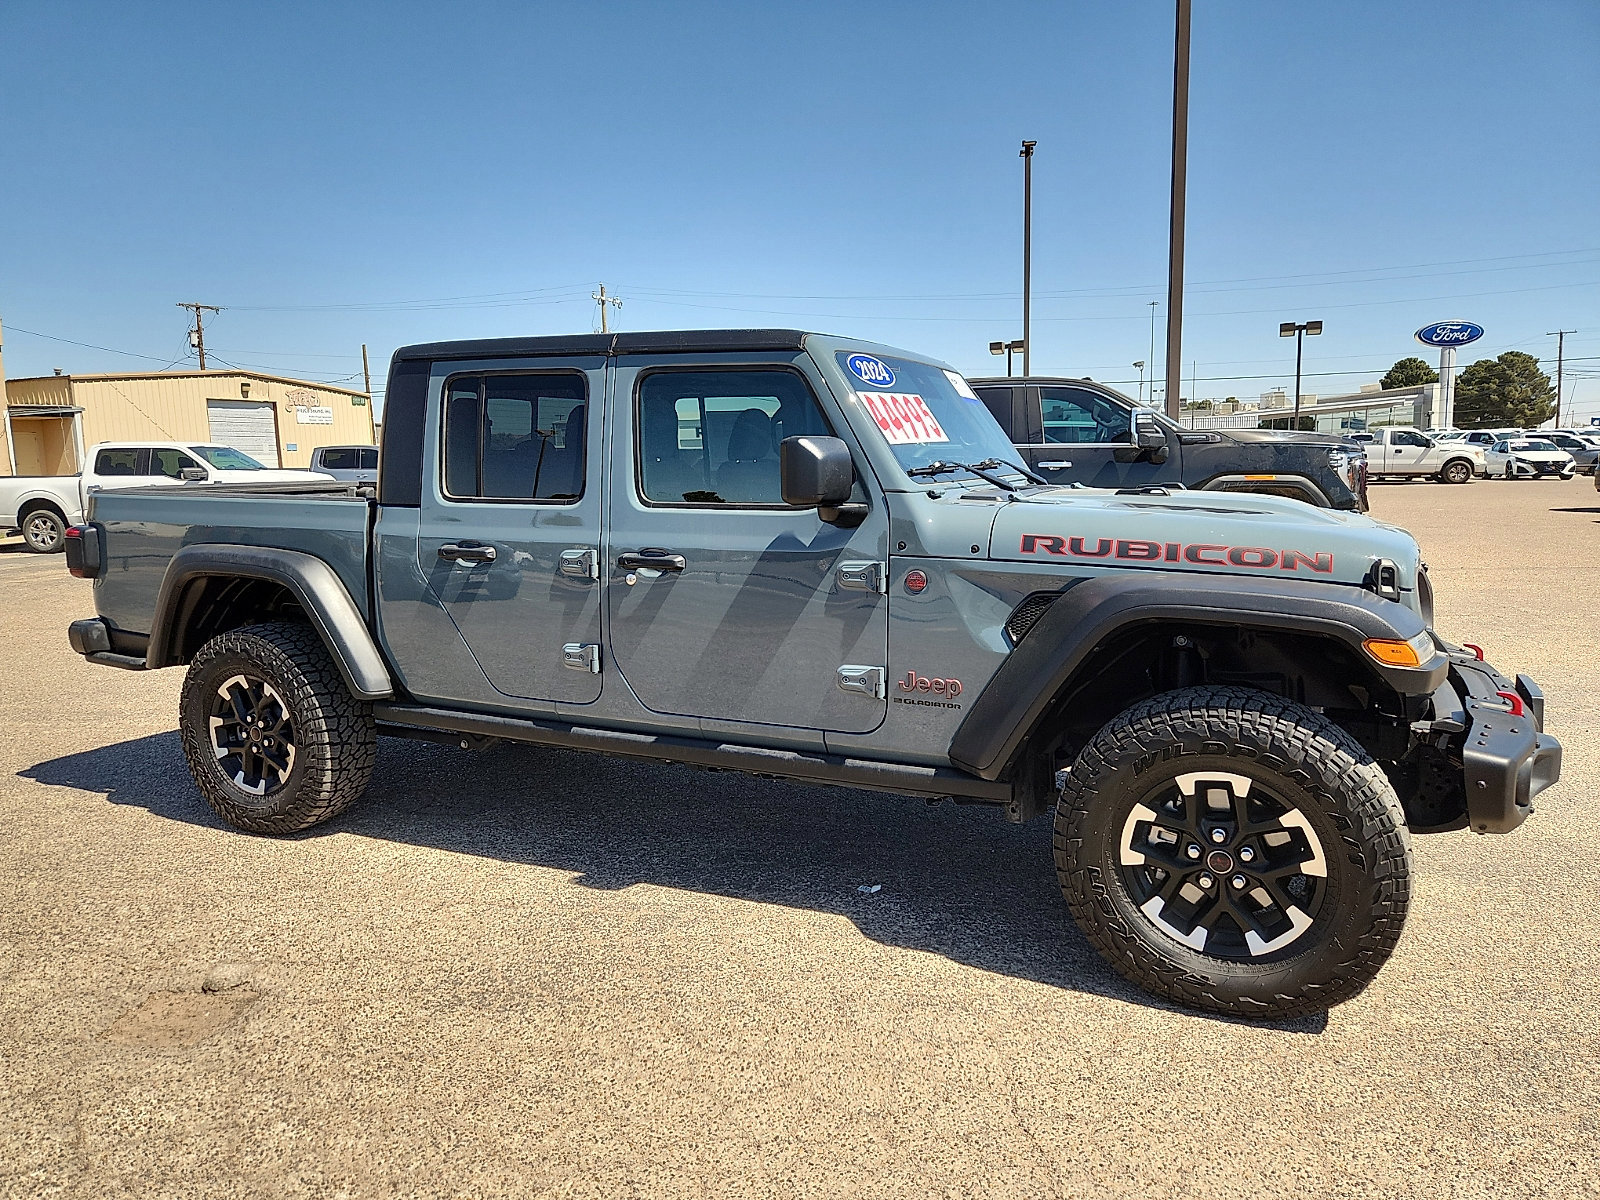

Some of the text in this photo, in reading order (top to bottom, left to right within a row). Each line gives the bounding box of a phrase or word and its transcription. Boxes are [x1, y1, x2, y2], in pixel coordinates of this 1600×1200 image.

[1432, 325, 1471, 341] Ford
[855, 359, 890, 381] 2024
[863, 394, 942, 440] 44995
[1020, 533, 1334, 573] RUBICON
[898, 669, 963, 699] Jeep
[903, 698, 962, 710] GLADIATOR
[1132, 740, 1336, 804] WILDPEAK
